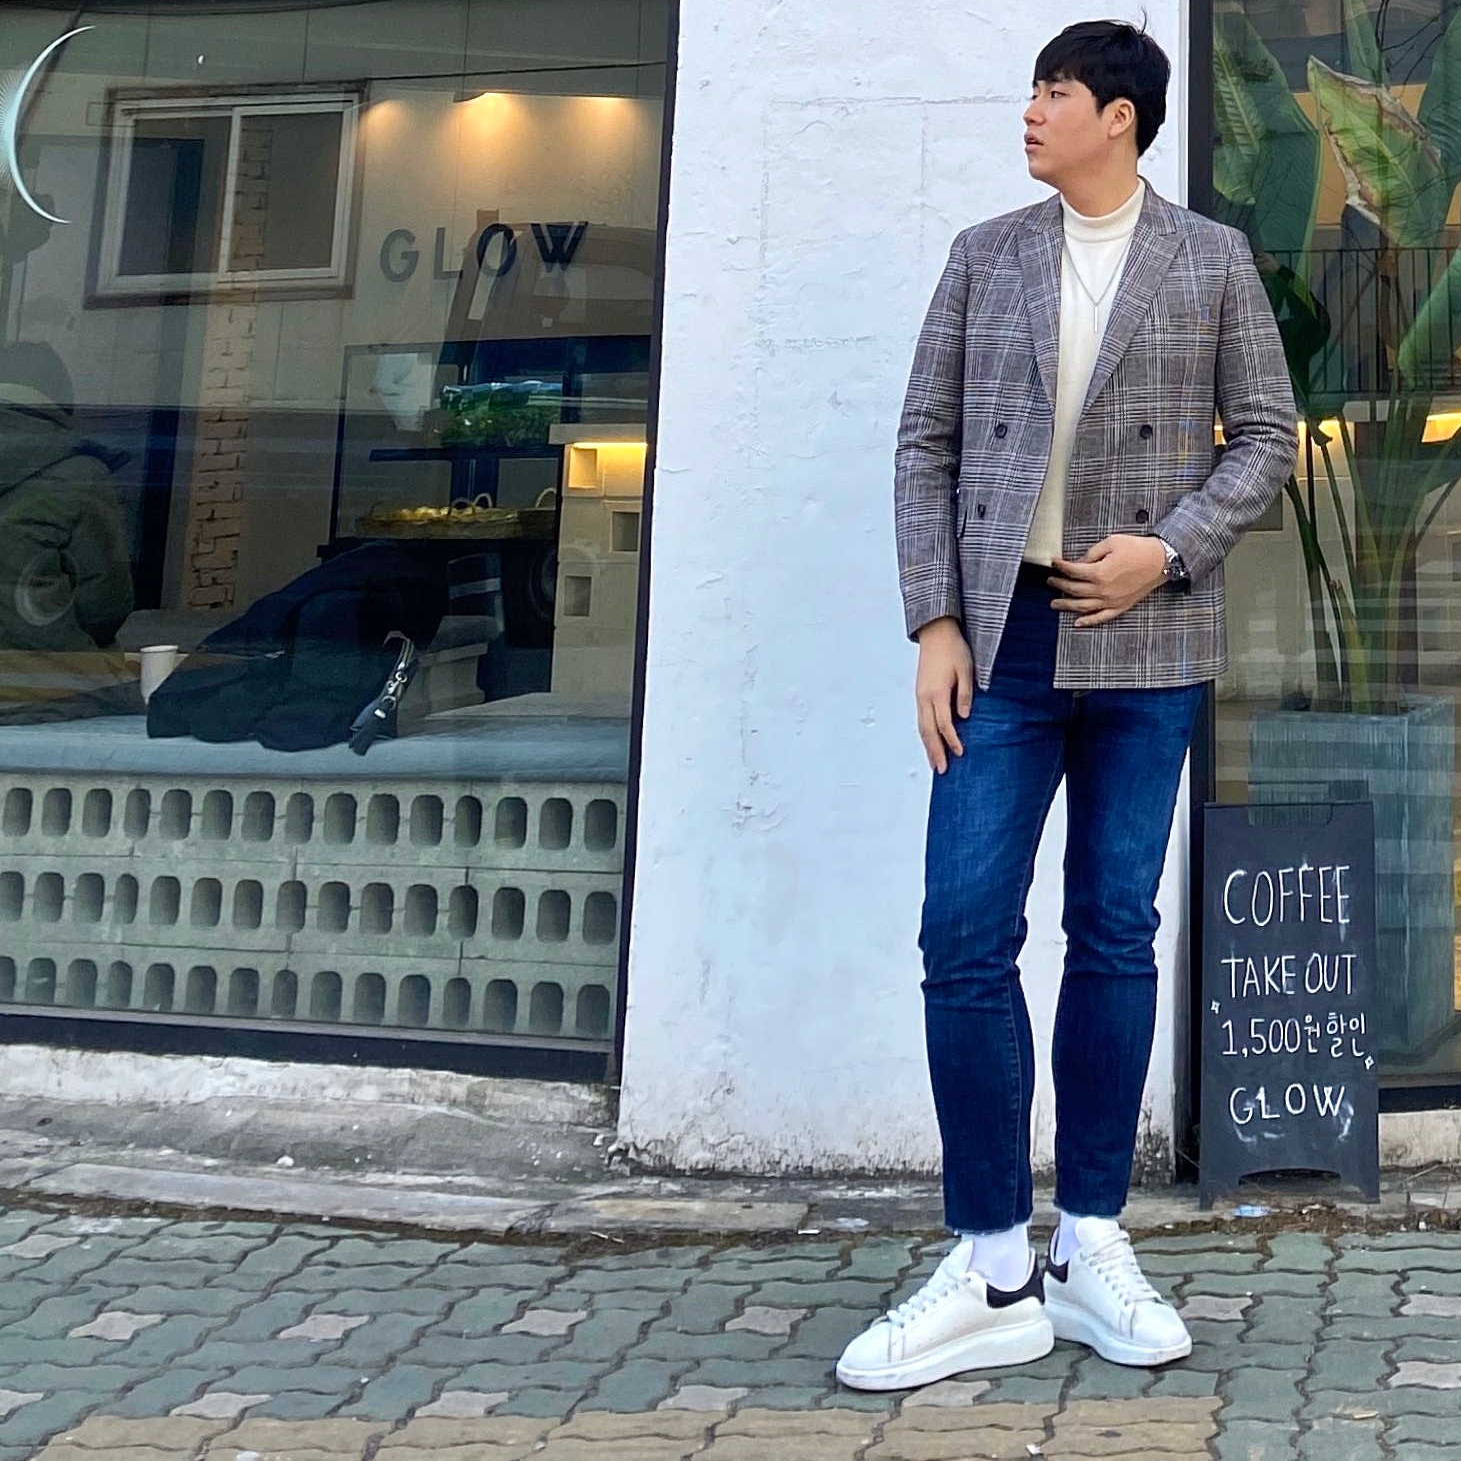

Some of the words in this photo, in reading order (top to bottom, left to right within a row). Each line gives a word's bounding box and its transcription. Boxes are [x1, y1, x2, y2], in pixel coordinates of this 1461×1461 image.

[378, 221, 589, 283] GLOW
[1222, 864, 1351, 927] COFFEE
[1220, 954, 1297, 999] TAKE
[1303, 952, 1357, 997] OUT
[1229, 1083, 1346, 1125] GLOW
